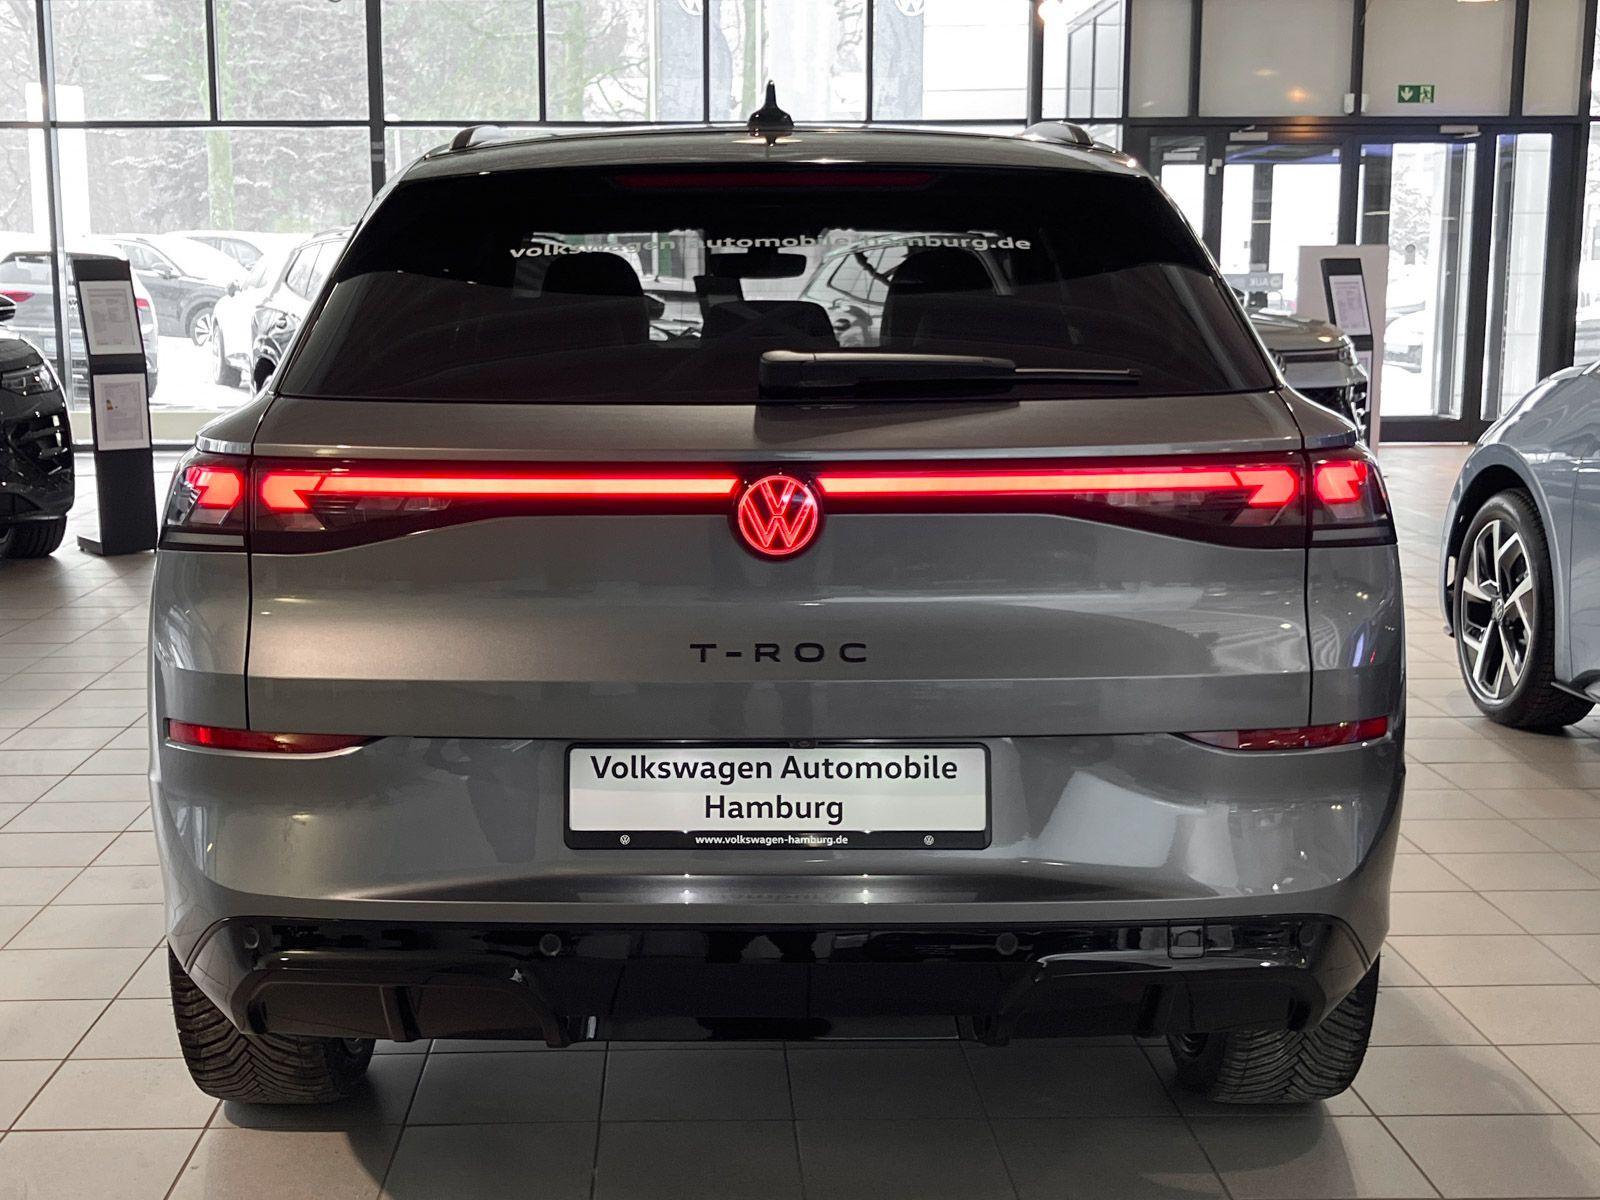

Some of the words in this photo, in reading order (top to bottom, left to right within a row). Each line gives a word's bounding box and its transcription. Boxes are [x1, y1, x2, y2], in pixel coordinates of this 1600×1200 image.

[689, 642, 867, 663] T-ROC
[590, 755, 772, 785] Volkswagen
[780, 754, 958, 780] Automobile
[704, 794, 844, 825] Hamburg
[695, 834, 849, 848] www.volkswagen-hamburg.de
